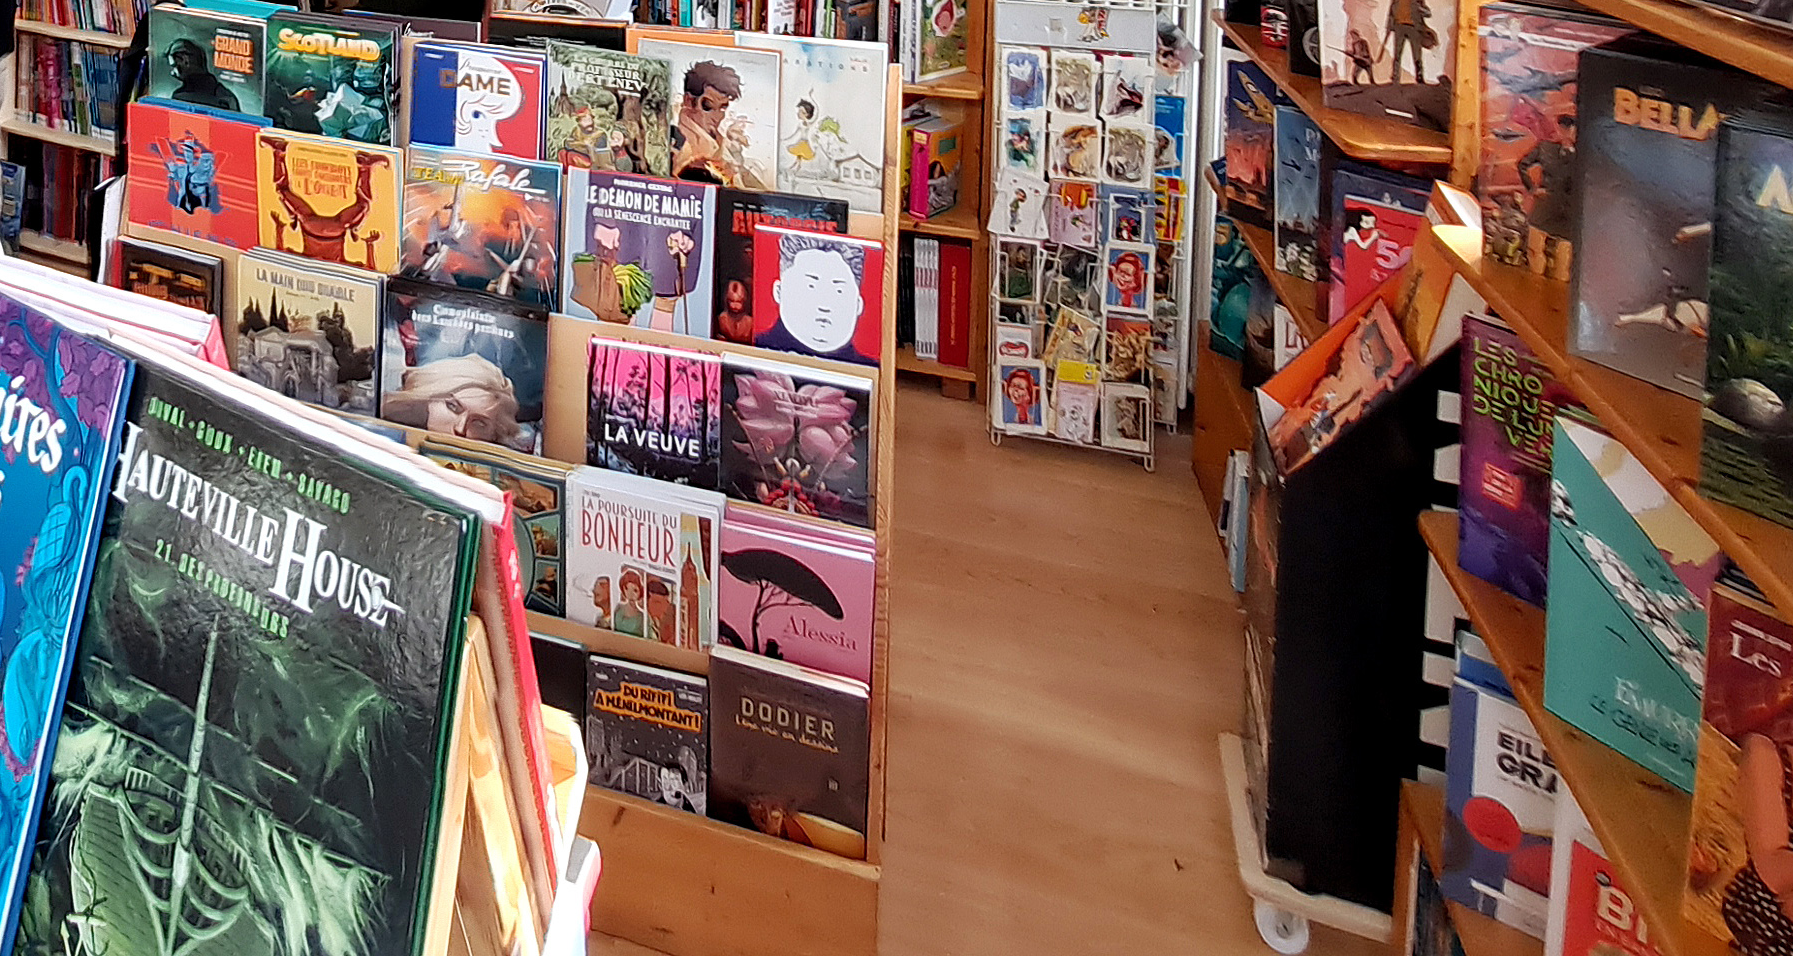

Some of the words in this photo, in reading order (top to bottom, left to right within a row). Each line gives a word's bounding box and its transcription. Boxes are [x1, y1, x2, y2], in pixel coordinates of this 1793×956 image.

[278, 28, 381, 61] SCOTLAND
[439, 68, 511, 96] DAME
[442, 159, 548, 194] Rafale
[599, 185, 641, 211] DÉMON
[644, 194, 660, 212] DE
[1473, 336, 1518, 366] LES
[604, 423, 629, 445] LA
[632, 427, 701, 458] VEUVE
[113, 421, 279, 566] HAUTEVILLE
[268, 505, 406, 628] HOUSE
[581, 495, 594, 511] LA
[598, 499, 658, 528] POURSUITE
[662, 511, 677, 530] DU
[581, 507, 677, 568] BONHEUR
[784, 614, 858, 652] Alessia
[1729, 630, 1782, 679] Les
[623, 684, 639, 701] DU
[740, 696, 837, 741] DODIER
